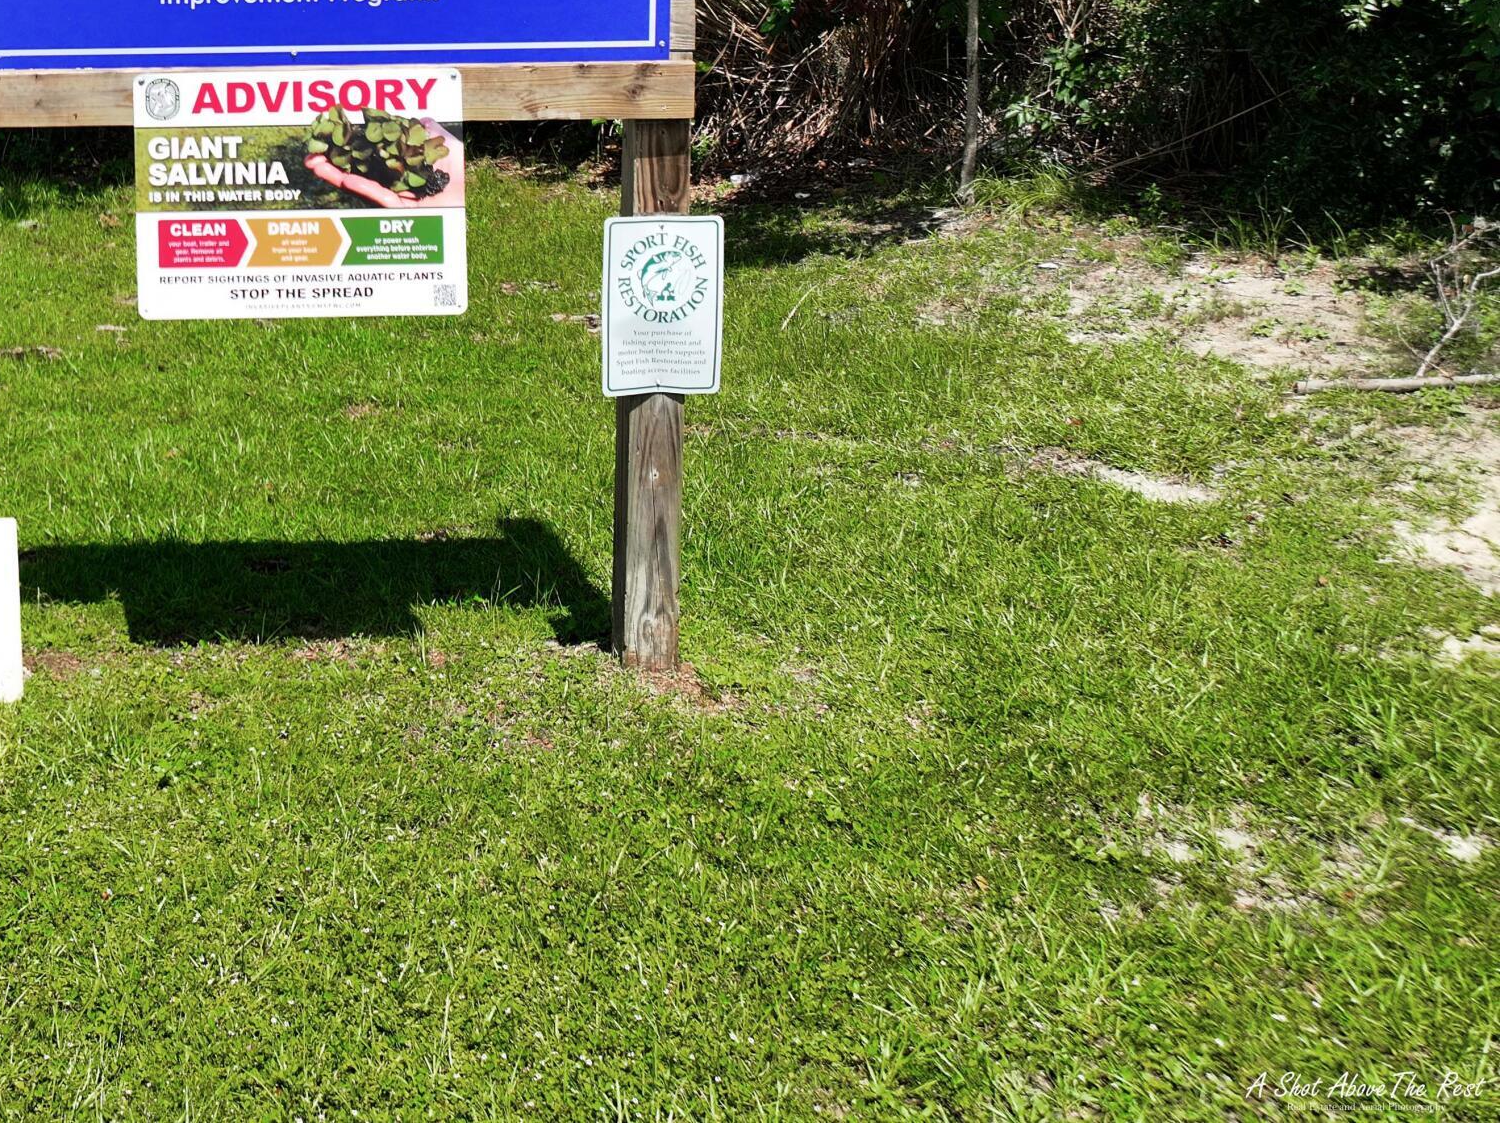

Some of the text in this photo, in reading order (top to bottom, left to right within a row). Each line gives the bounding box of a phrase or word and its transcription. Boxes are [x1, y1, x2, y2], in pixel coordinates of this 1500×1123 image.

[191, 78, 438, 115] ADVISORY
[147, 136, 243, 160] GIANT
[148, 161, 290, 187] SALVINIA
[149, 189, 301, 203] IS IN THIS WATER BODY
[170, 222, 227, 237] CLEAN
[267, 221, 319, 236] DRAIN
[379, 219, 414, 234] DRY
[621, 232, 707, 271] SPORT FISH
[159, 271, 444, 284] REPORT SIGHTINGS OF INVASIVE AQUATIC PLANTS
[230, 287, 374, 300] STOP THE SPREAD
[617, 276, 709, 324] RESTORATION
